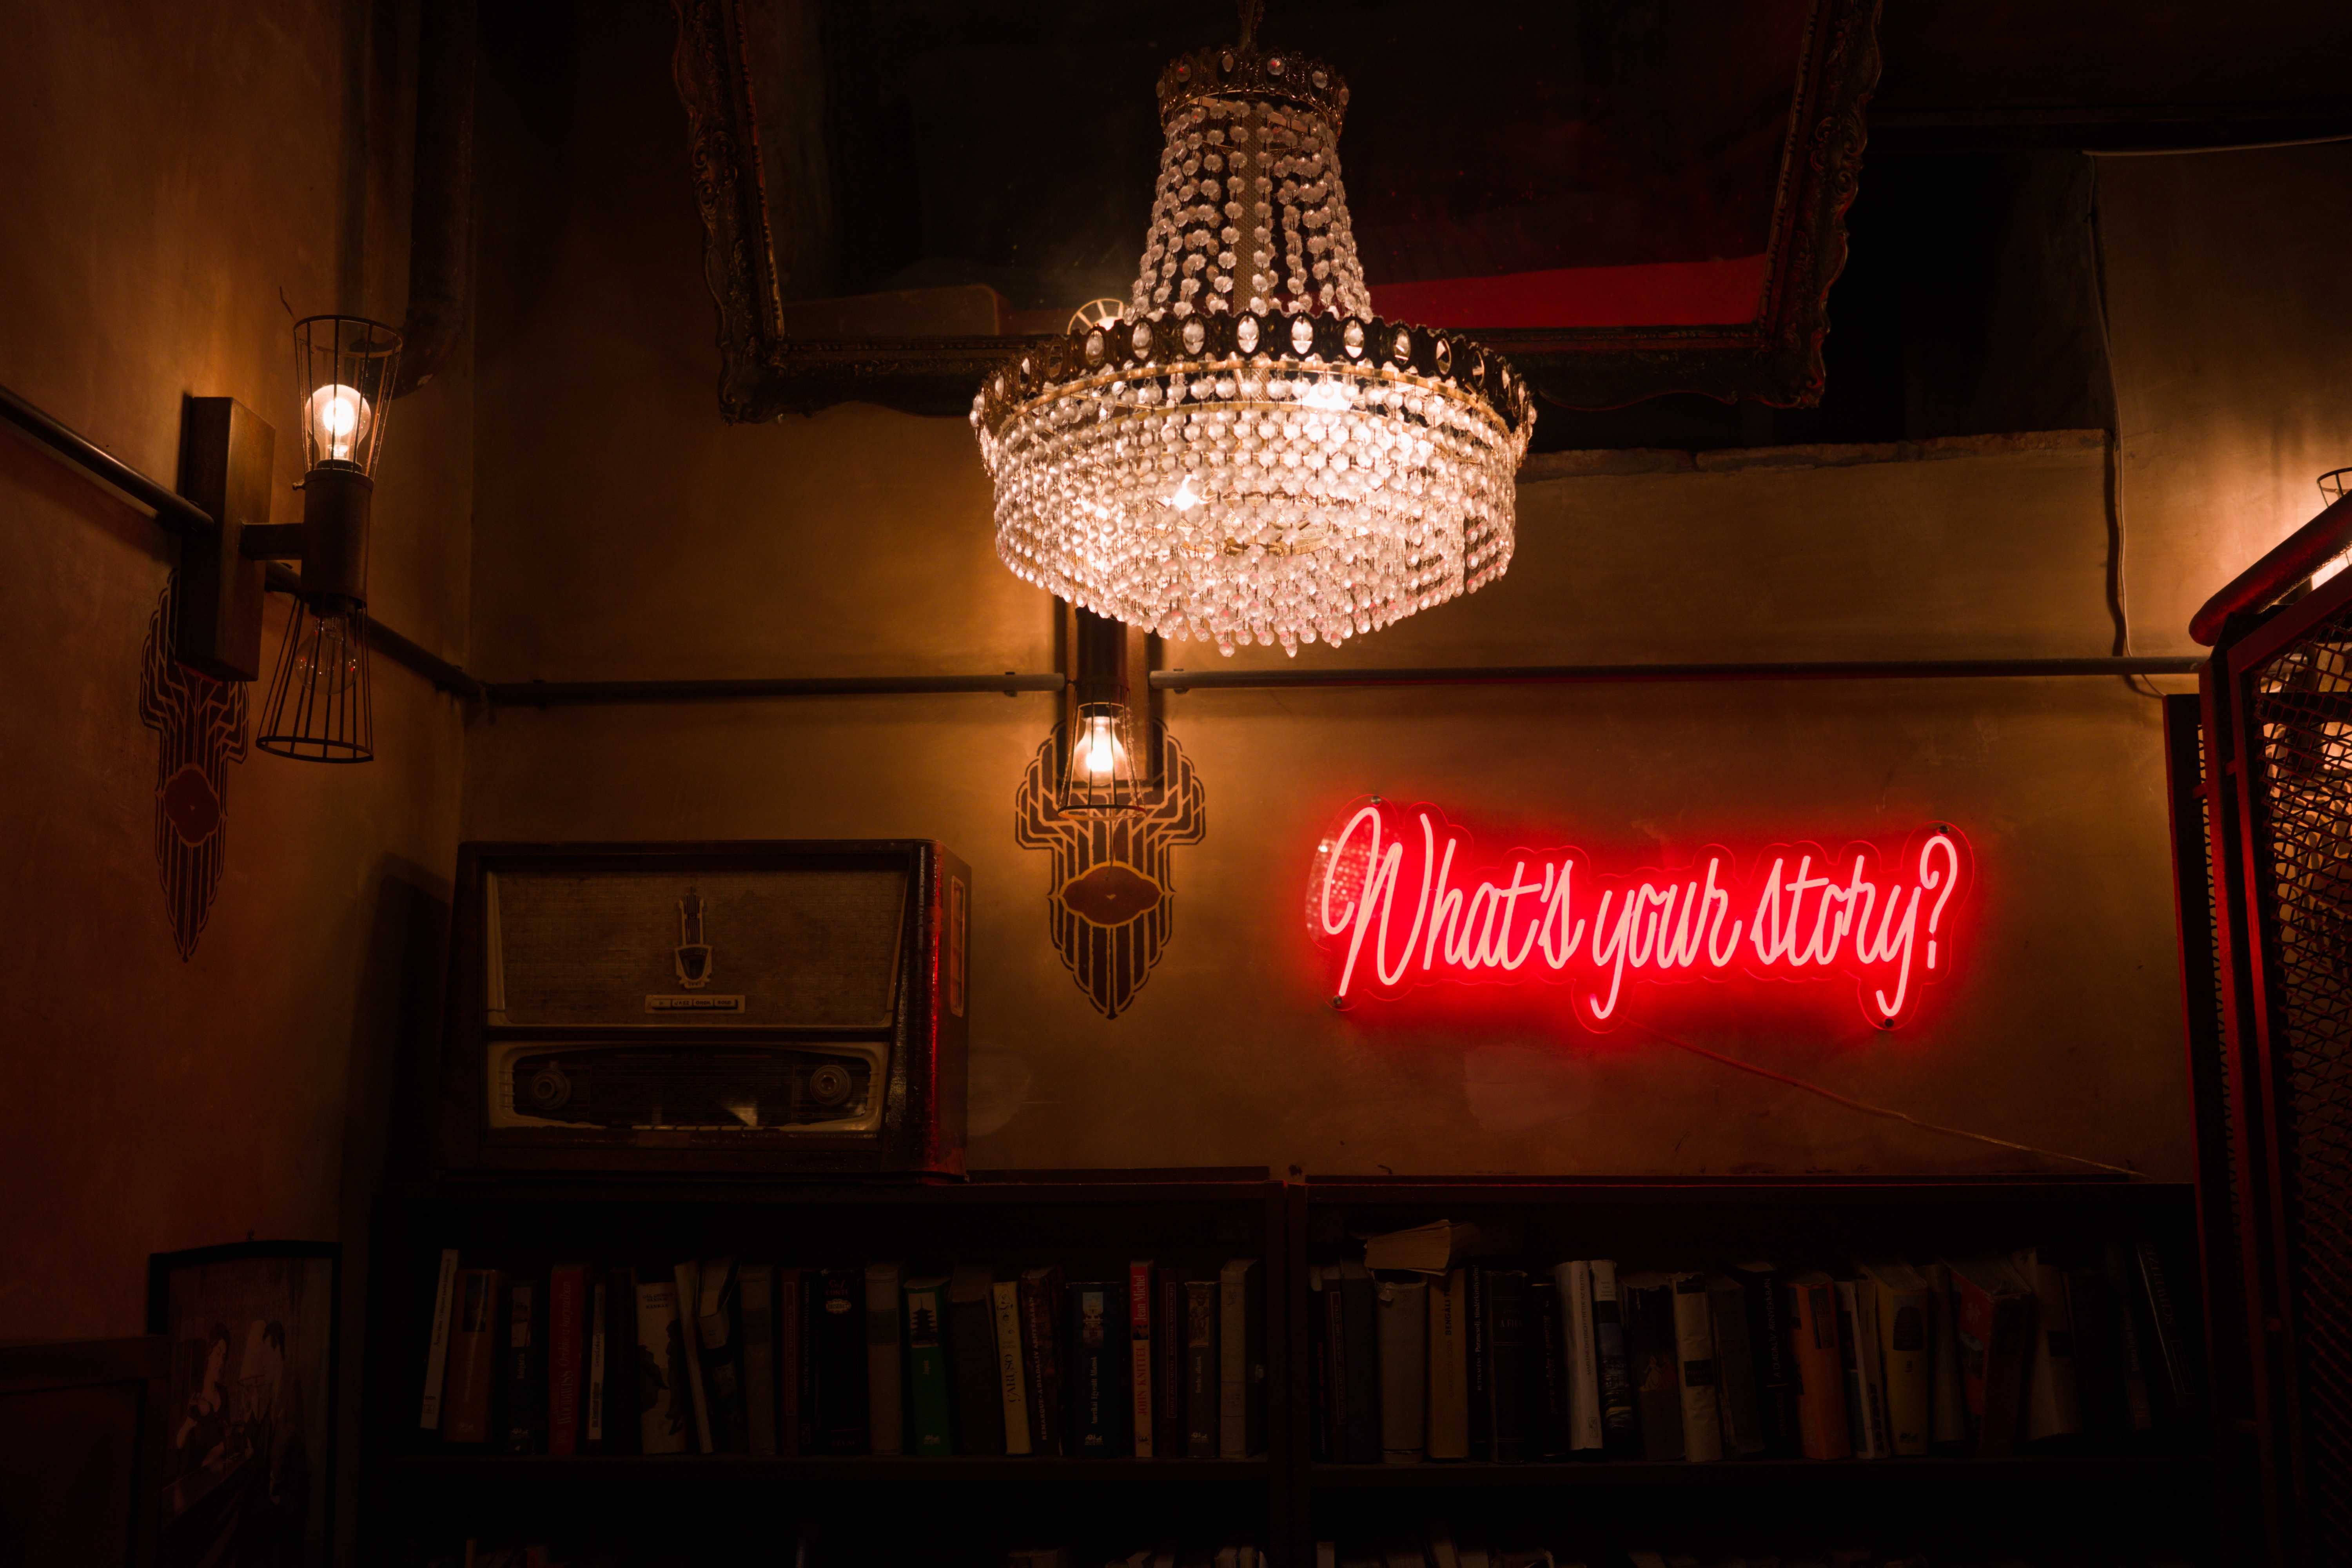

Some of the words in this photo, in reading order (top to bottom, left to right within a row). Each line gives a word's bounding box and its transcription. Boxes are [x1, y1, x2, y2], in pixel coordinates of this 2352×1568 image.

[1321, 806, 1584, 996] What's
[1590, 857, 1742, 1019] your
[1751, 835, 1958, 1017] story?
[1132, 1275, 1146, 1301] Michel
[1134, 1303, 1148, 1321] Jean
[1442, 1299, 1452, 1336] BENGÁLI
[1004, 1354, 1021, 1403] CARUSO
[1134, 1346, 1147, 1387] KNITTEL
[1090, 1401, 1098, 1425] Amerikai
[1136, 1390, 1148, 1416] JOHN
